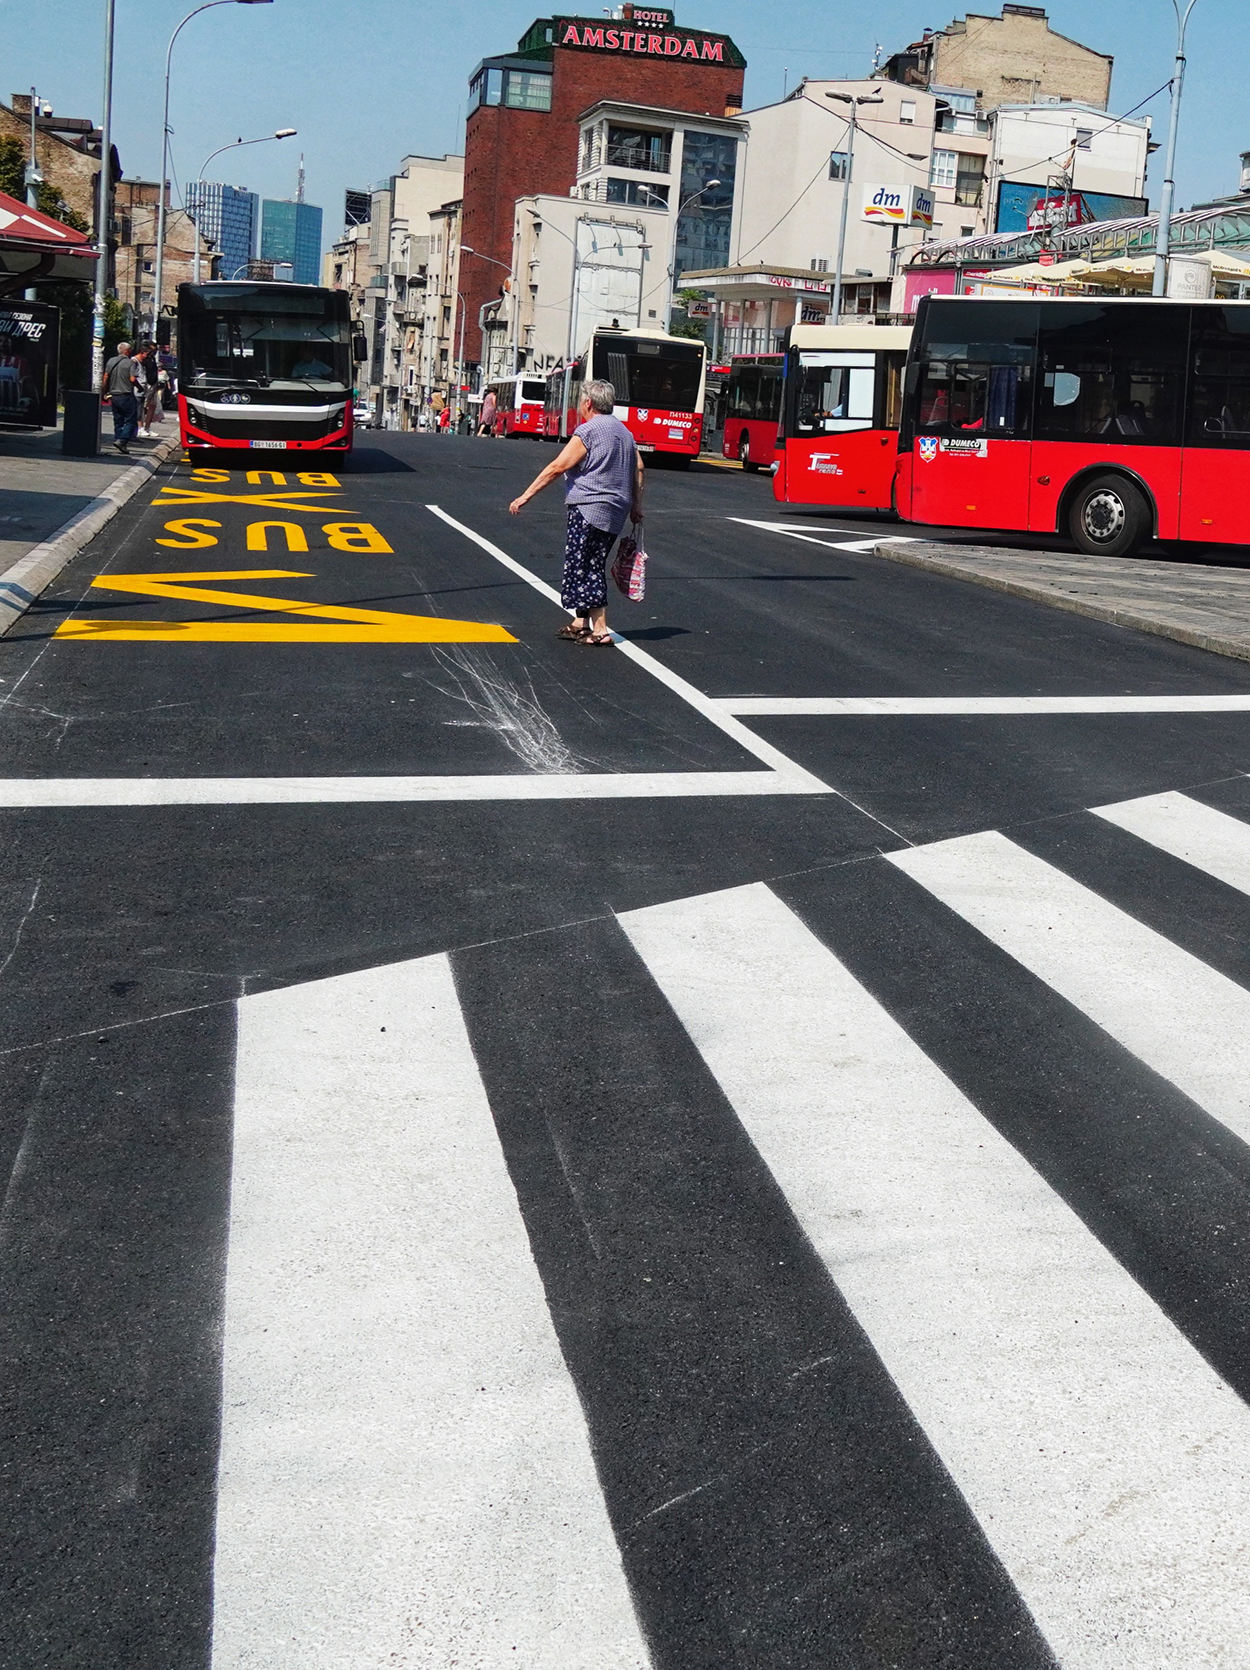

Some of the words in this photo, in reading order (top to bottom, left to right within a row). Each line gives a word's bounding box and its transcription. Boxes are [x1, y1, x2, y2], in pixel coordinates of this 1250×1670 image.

[633, 10, 669, 22] HOTEL
[562, 26, 724, 61] AMSTERDAM
[872, 188, 901, 206] dm
[916, 193, 931, 213] dm
[694, 304, 709, 312] dm
[12, 322, 47, 338] ДРЕС
[662, 418, 692, 428] DUMECO
[950, 439, 981, 448] DUMECO
[190, 468, 342, 488] BUS
[155, 518, 395, 554] BUS
